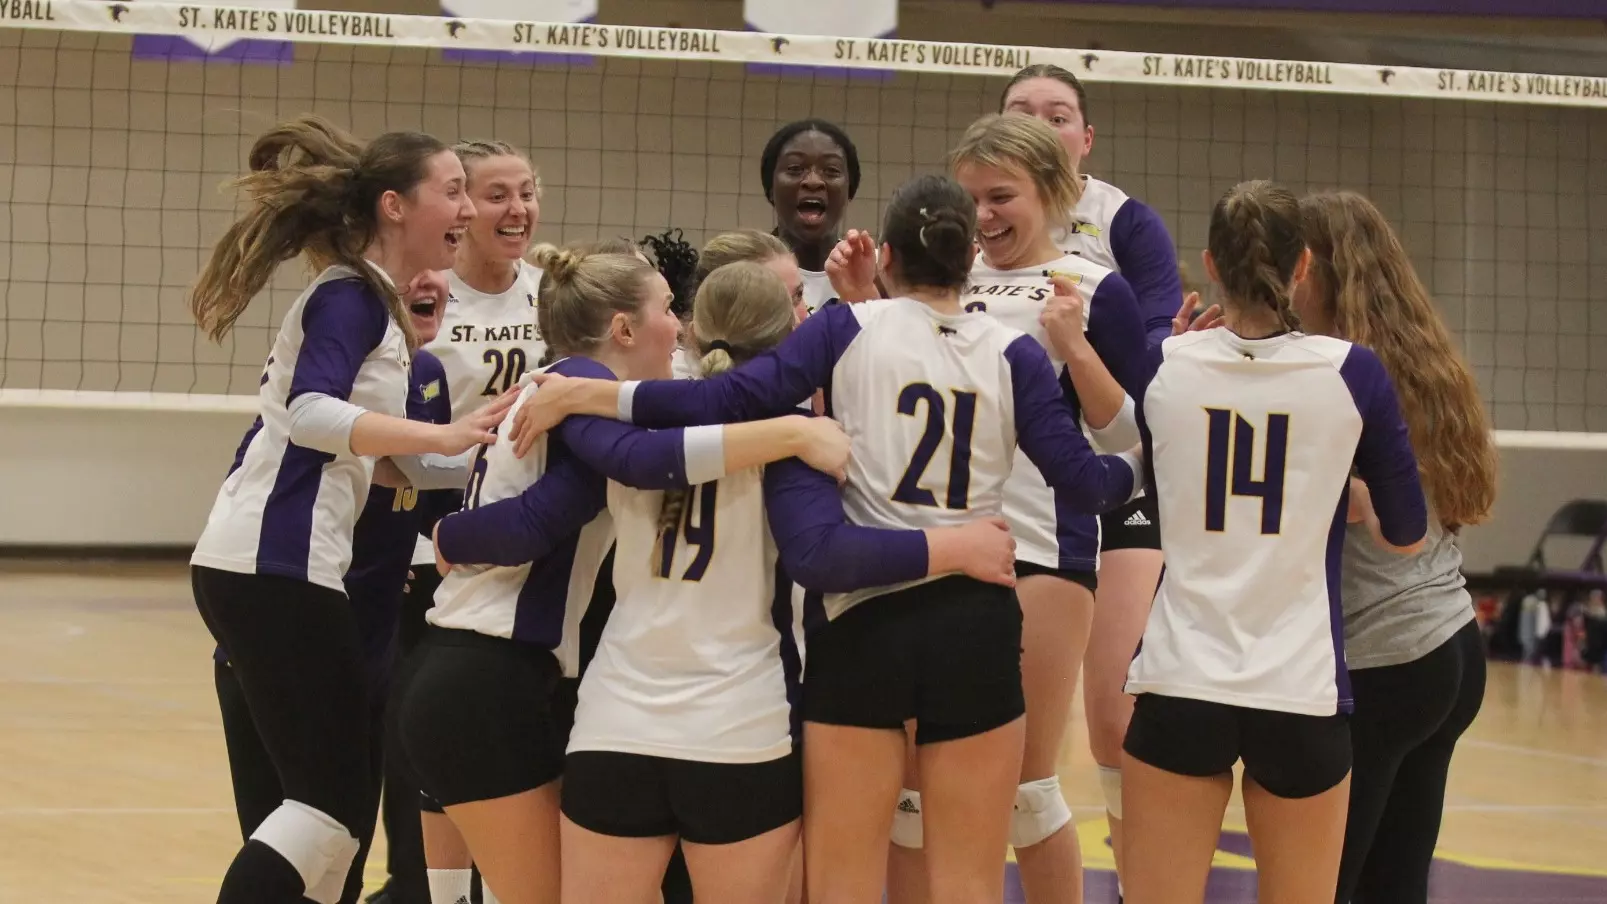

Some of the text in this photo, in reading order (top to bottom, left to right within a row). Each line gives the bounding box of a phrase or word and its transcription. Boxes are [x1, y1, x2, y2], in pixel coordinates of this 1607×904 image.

[179, 7, 394, 38] ST. KATE'S VOLLEYBALL
[513, 24, 720, 52] ST. KATE'S VOLLEYBALL
[834, 40, 860, 60] ST.
[867, 42, 926, 64] KATE'S
[1143, 56, 1333, 84] ST. KATE'S VOLLEYBALL
[1437, 71, 1461, 91] ST.
[1467, 71, 1521, 93] KATE'S
[968, 284, 1050, 302] KATE'S
[450, 325, 478, 342] ST.
[481, 347, 527, 397] 20
[890, 381, 978, 511] 21
[1200, 406, 1291, 536] 14
